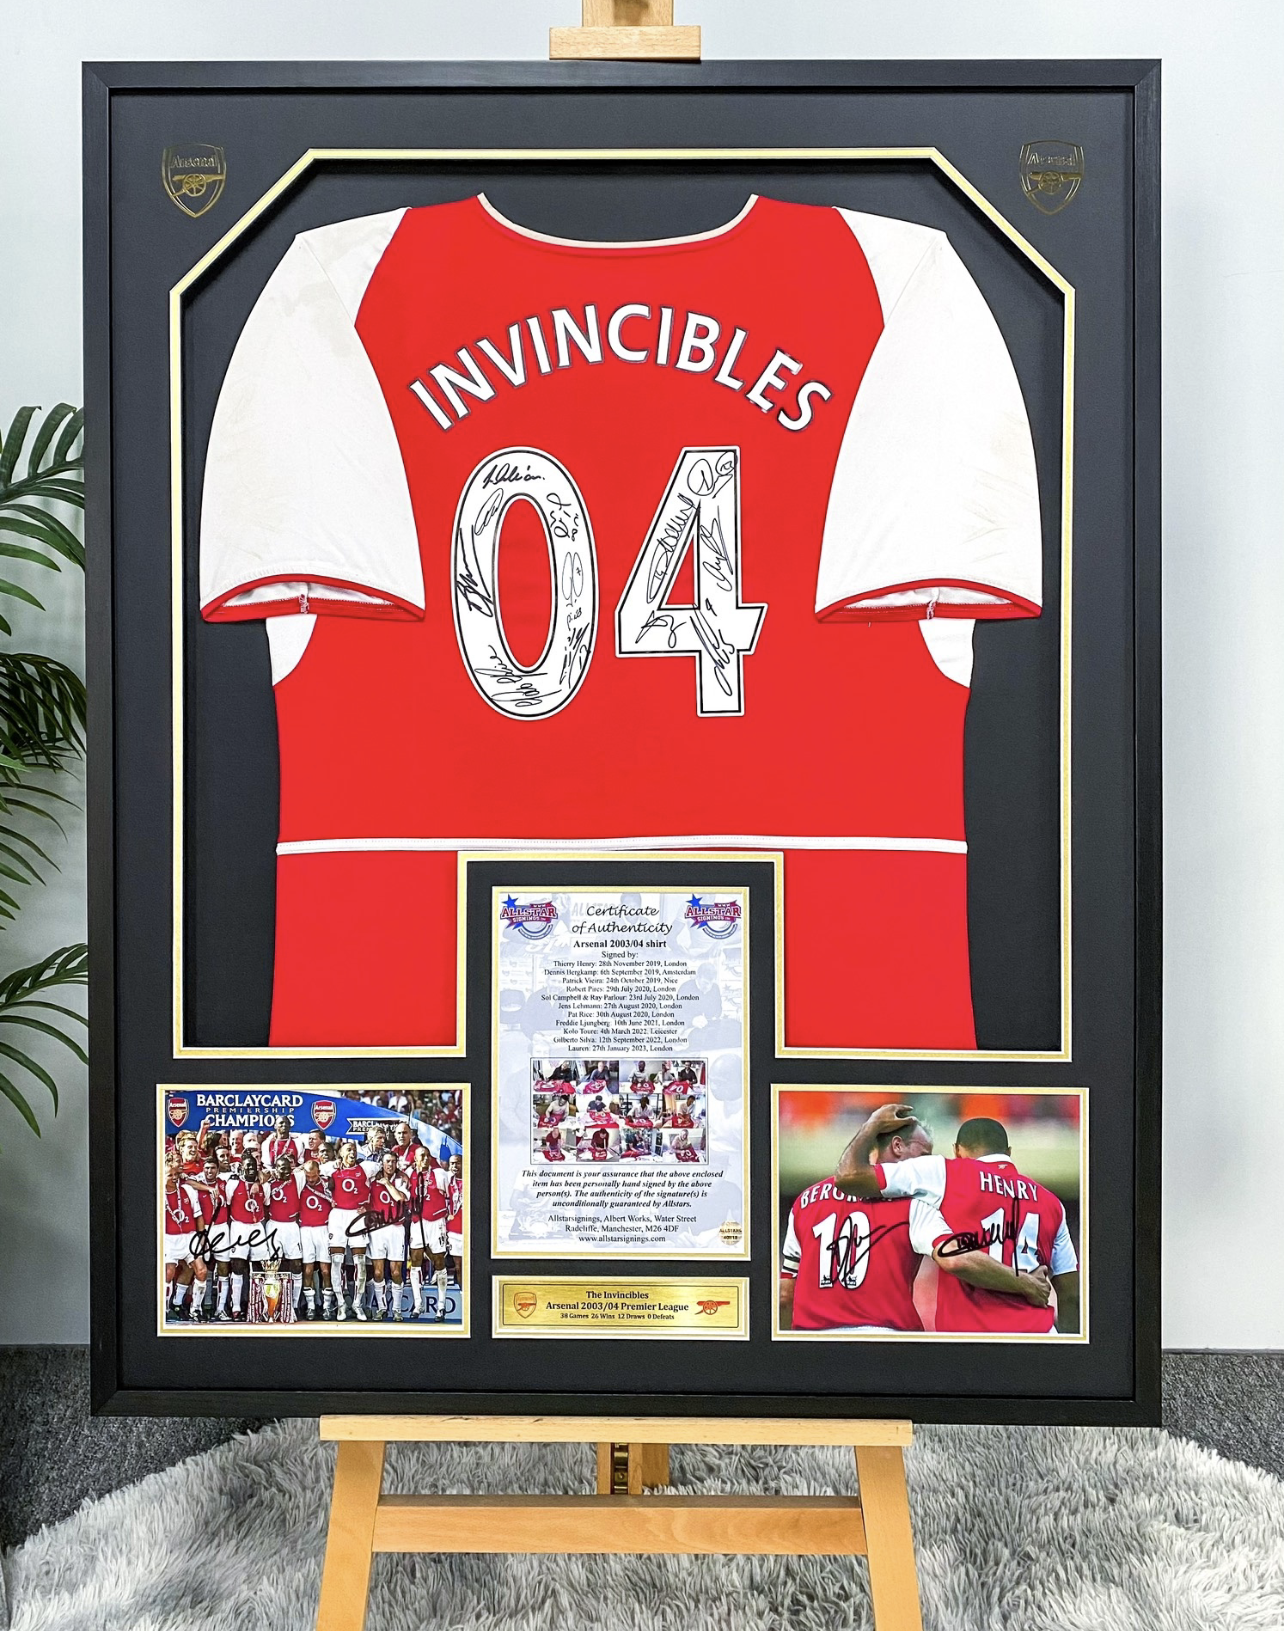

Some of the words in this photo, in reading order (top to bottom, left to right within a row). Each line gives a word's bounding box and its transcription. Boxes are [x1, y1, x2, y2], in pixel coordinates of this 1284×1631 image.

[409, 302, 834, 433] INVINCIBLES
[450, 445, 769, 722] 04
[501, 907, 556, 918] ALLSTAR
[586, 904, 659, 918] Certificate
[686, 906, 741, 916] ALLSTAR
[572, 921, 587, 935] of
[588, 921, 673, 935] Authenticity
[573, 940, 607, 948] Arsenal
[610, 940, 644, 948] 2003/04
[645, 940, 667, 948] shirt
[601, 951, 626, 959] Signed
[627, 951, 639, 959] by:
[553, 960, 575, 968] Thierry
[577, 960, 598, 968] Henry:
[646, 960, 663, 968] 2019,
[566, 969, 598, 977] Bergkamp:
[611, 969, 643, 977] September
[644, 969, 661, 977] 2019,
[646, 977, 663, 985] 2019,
[620, 986, 633, 994] July
[635, 986, 652, 994] 2020,
[552, 994, 581, 1002] Campbell
[590, 994, 602, 1002] Ray
[644, 994, 656, 1002] July
[658, 994, 675, 1002] 2020,
[611, 1011, 632, 1019] August
[633, 1011, 650, 1019] 2020,
[632, 1028, 649, 1036] 2022,
[607, 1045, 630, 1053] January
[631, 1045, 649, 1053] 2023,
[196, 1094, 303, 1107] BARCLAYCARD
[206, 1114, 295, 1127] CHAMPIOS
[583, 1170, 601, 1179] your
[582, 1180, 621, 1189] personally
[642, 1180, 666, 1189] signed
[667, 1180, 676, 1189] by
[980, 1170, 1038, 1202] HENRY
[536, 1190, 572, 1199] person(s).
[590, 1190, 633, 1199] authenticity
[634, 1190, 642, 1199] of
[656, 1190, 699, 1199] signature(s)
[552, 1200, 609, 1209] unconditionally
[610, 1200, 651, 1209] guaranteed
[652, 1200, 662, 1209] by
[548, 1215, 602, 1223] Allstarsignings,
[628, 1215, 652, 1223] Works,
[565, 1225, 599, 1233] Radcliffe,
[601, 1225, 644, 1233] Manchester,
[578, 1235, 666, 1244] www.allstarsignings.com
[980, 1207, 1040, 1273] 14
[812, 1211, 871, 1289] 10
[586, 1291, 602, 1299] The
[604, 1291, 649, 1299] Invincibles
[546, 1302, 579, 1310] Arsenal
[581, 1302, 619, 1311] 2003/04
[621, 1302, 656, 1310] Premier
[658, 1303, 689, 1312] League
